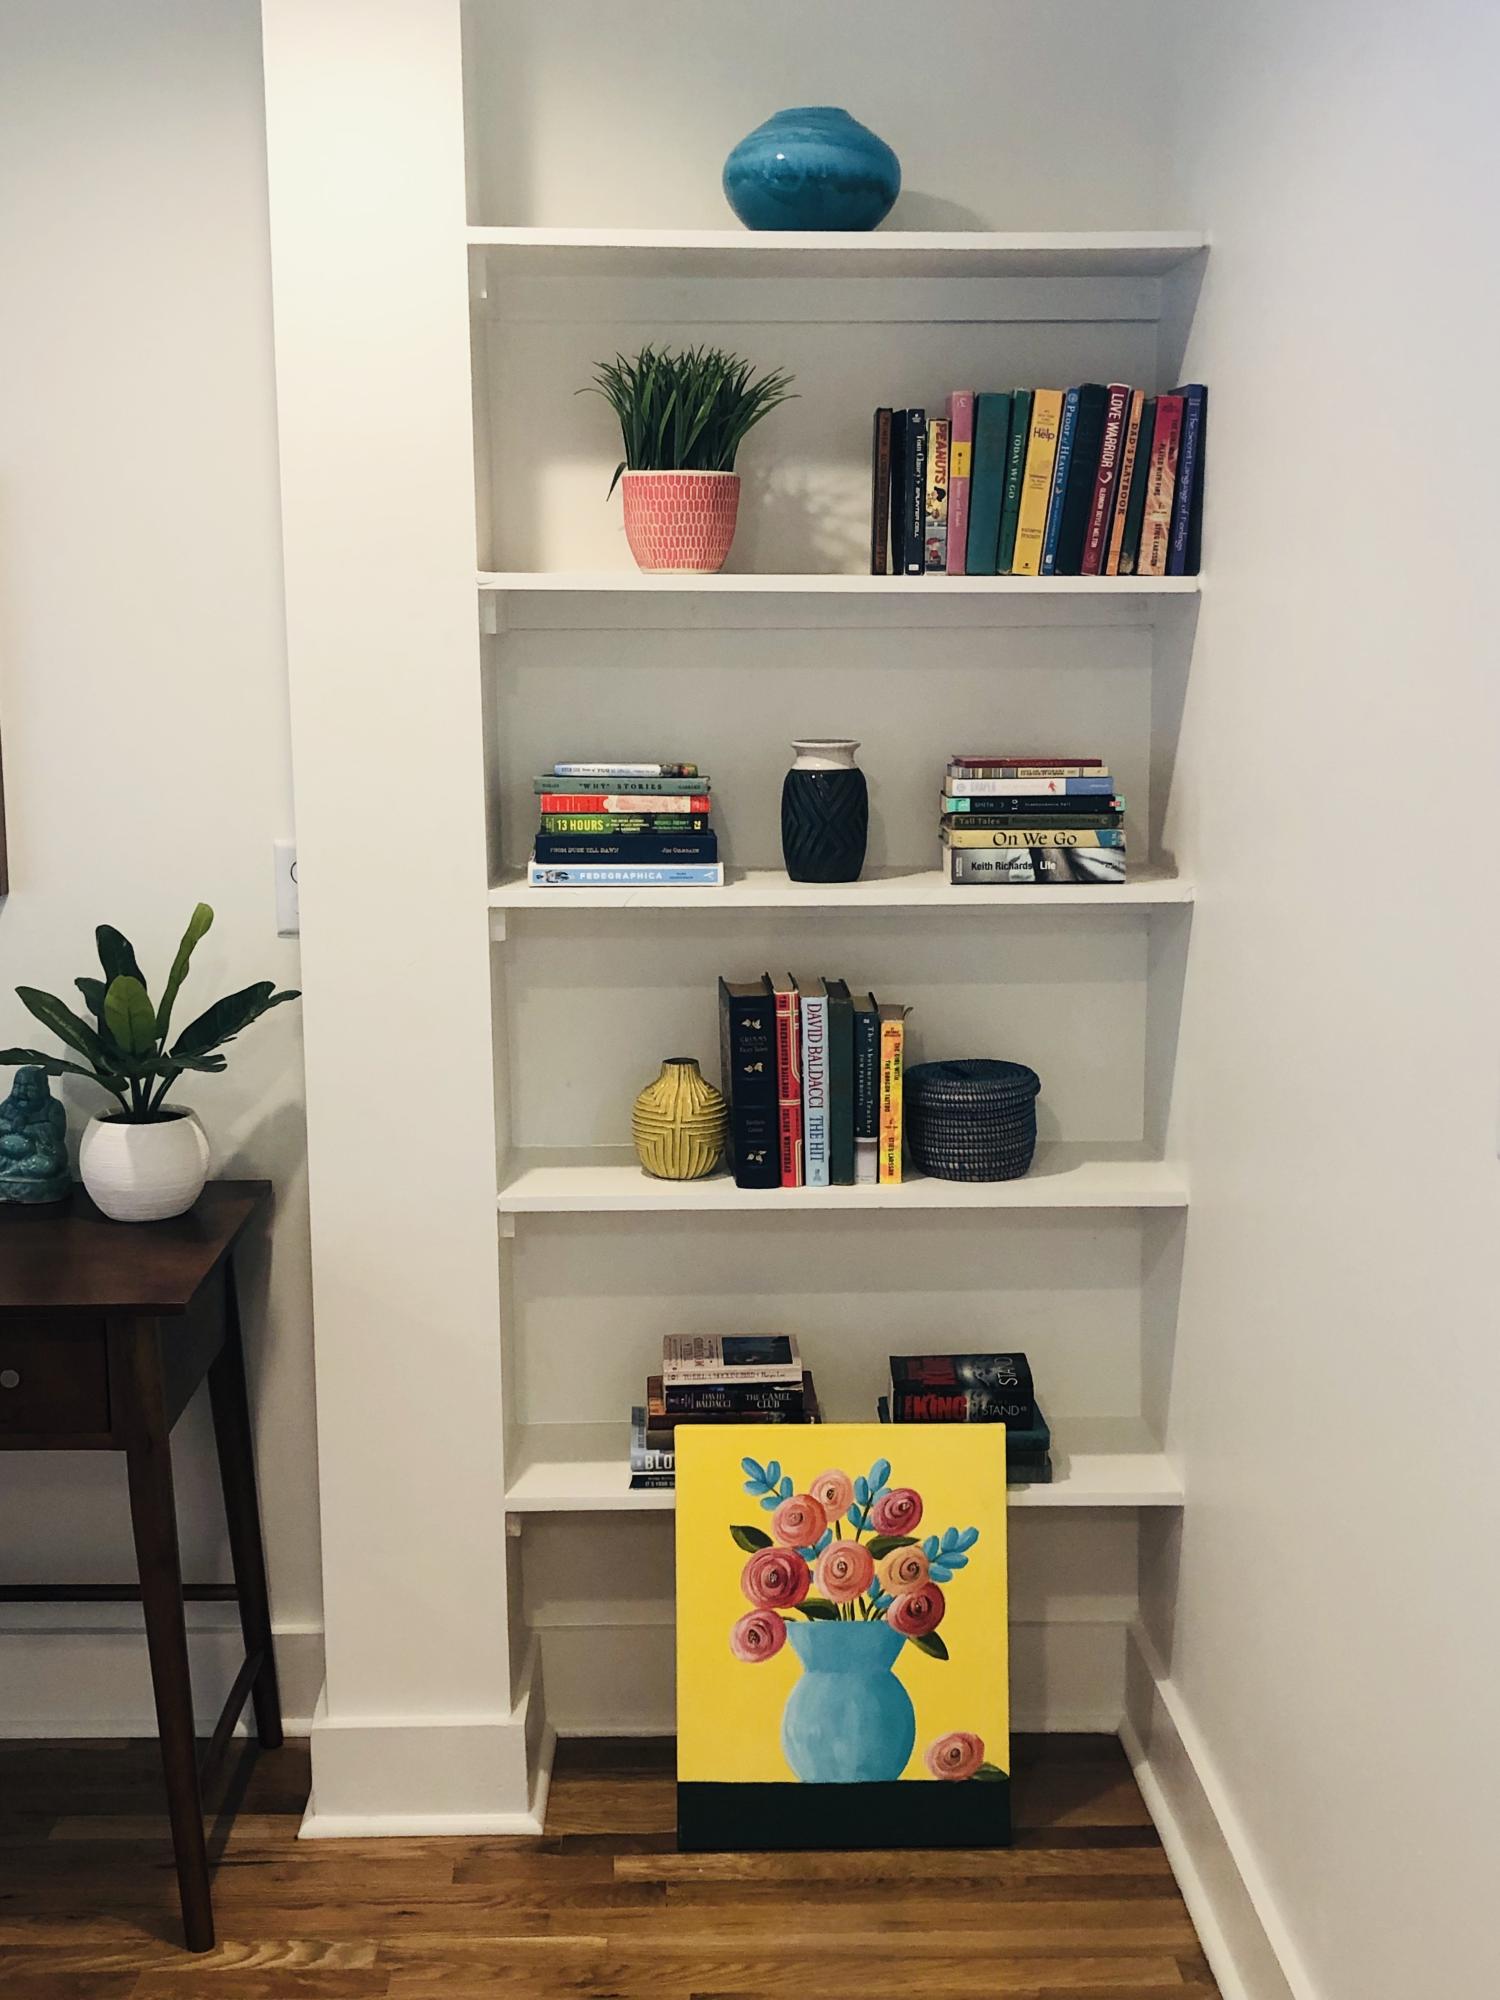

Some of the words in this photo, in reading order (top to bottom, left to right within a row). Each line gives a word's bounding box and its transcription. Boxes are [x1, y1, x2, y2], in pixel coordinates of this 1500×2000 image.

[1109, 394, 1124, 418] LOVE
[1188, 412, 1198, 429] The
[1034, 426, 1055, 441] Help
[1127, 422, 1138, 454] DAD'S
[915, 434, 925, 452] Tom
[1011, 433, 1022, 464] TODAY
[1101, 422, 1120, 468] WARRIOR
[1185, 431, 1196, 460] Secret
[934, 422, 948, 484] PEANUTS
[1010, 468, 1018, 481] WE
[1180, 461, 1193, 503] Language
[1008, 485, 1016, 498] GO
[1118, 458, 1134, 516] PLAYBOOK
[1180, 504, 1189, 515] of
[556, 820, 568, 830] 13
[570, 820, 604, 831] HOURS
[993, 832, 1018, 846] On
[1023, 832, 1048, 845] We
[1054, 832, 1077, 846] Go
[971, 861, 992, 870] Keith
[995, 860, 1033, 870] Richards
[1040, 861, 1056, 870] Life
[580, 872, 662, 880] FEDEGRAPHICA
[807, 1004, 822, 1043] DAVID
[808, 1046, 823, 1108] BALDACCI
[809, 1116, 824, 1140] THE
[810, 1142, 824, 1163] HIT
[696, 1400, 731, 1408] BALDACCI
[757, 1400, 780, 1408] CLUB
[914, 1395, 967, 1420] KING
[983, 1404, 1020, 1416] STAND
[645, 1455, 672, 1470] BLO
